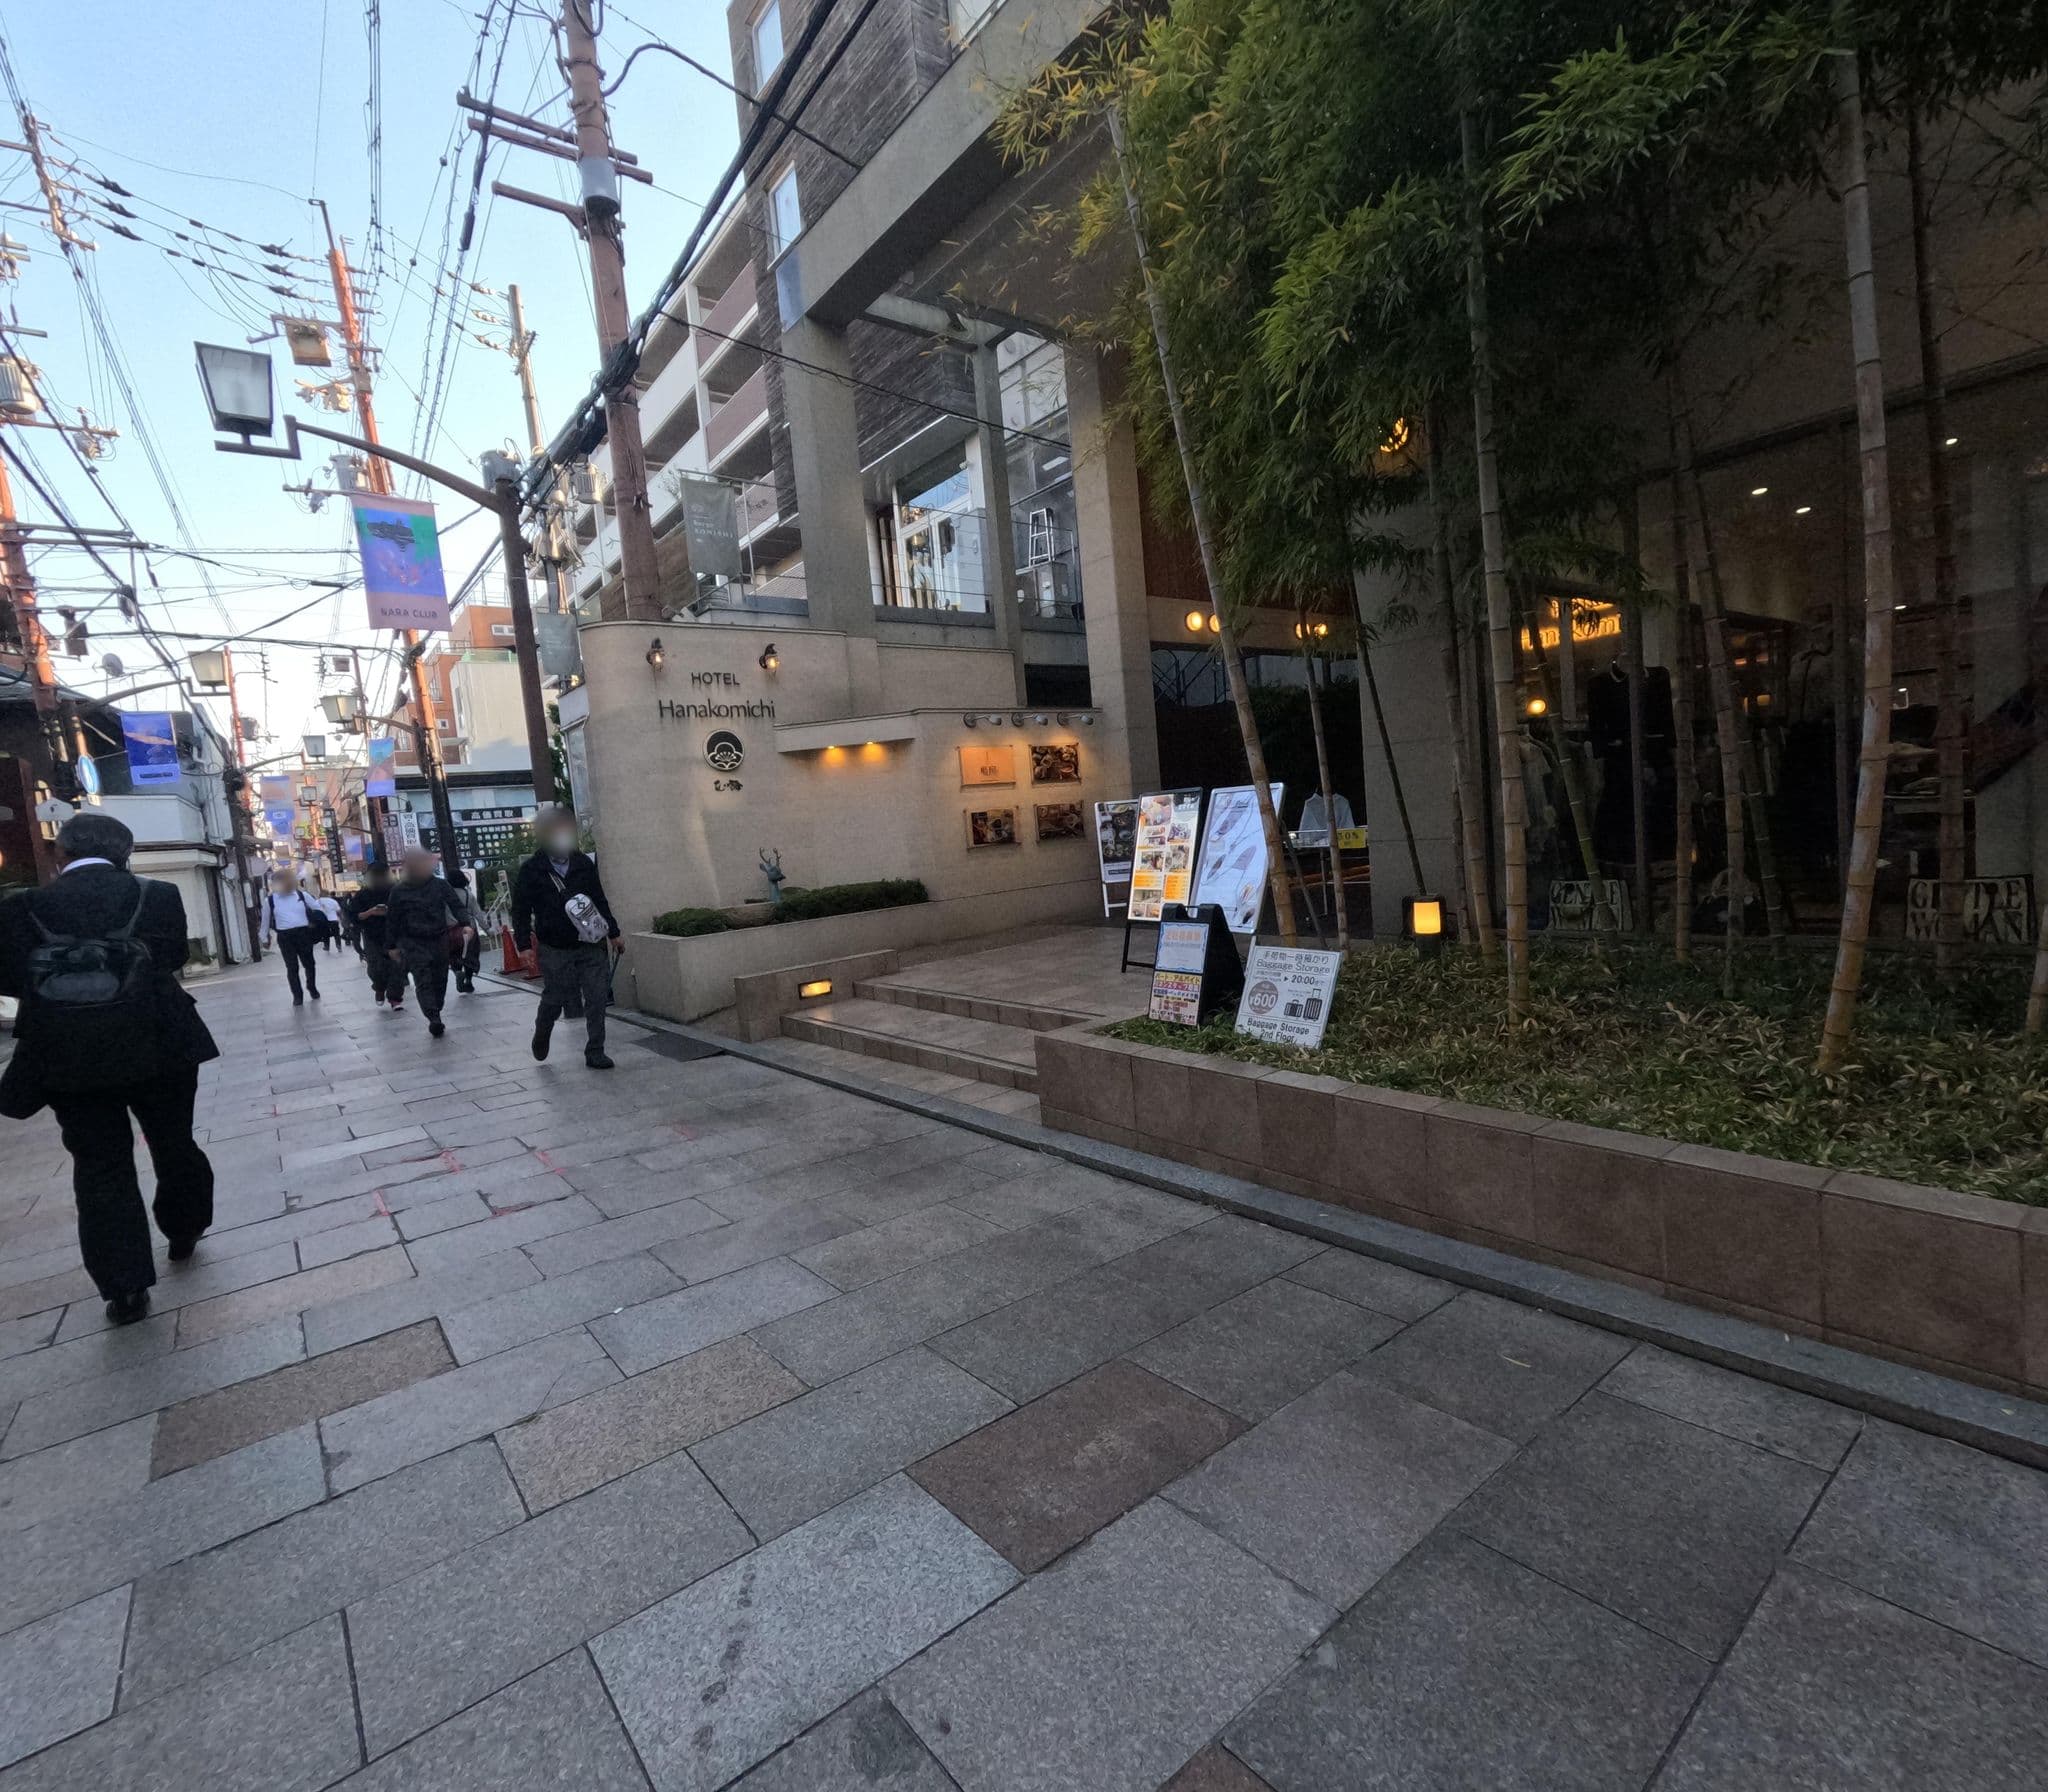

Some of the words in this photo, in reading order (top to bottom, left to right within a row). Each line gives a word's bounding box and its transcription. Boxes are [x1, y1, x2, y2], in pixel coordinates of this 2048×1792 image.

[381, 607, 410, 617] NARA
[412, 608, 439, 619] CLUB
[690, 671, 741, 687] HOTEL
[658, 697, 776, 719] Hanakomichi
[1256, 958, 1293, 971] Baggage
[1295, 961, 1331, 974] Storage
[1291, 974, 1315, 986] 20:00
[1247, 1017, 1278, 1031] Baggage
[1280, 1022, 1311, 1035] Storage
[1260, 1029, 1273, 1039] 2nd
